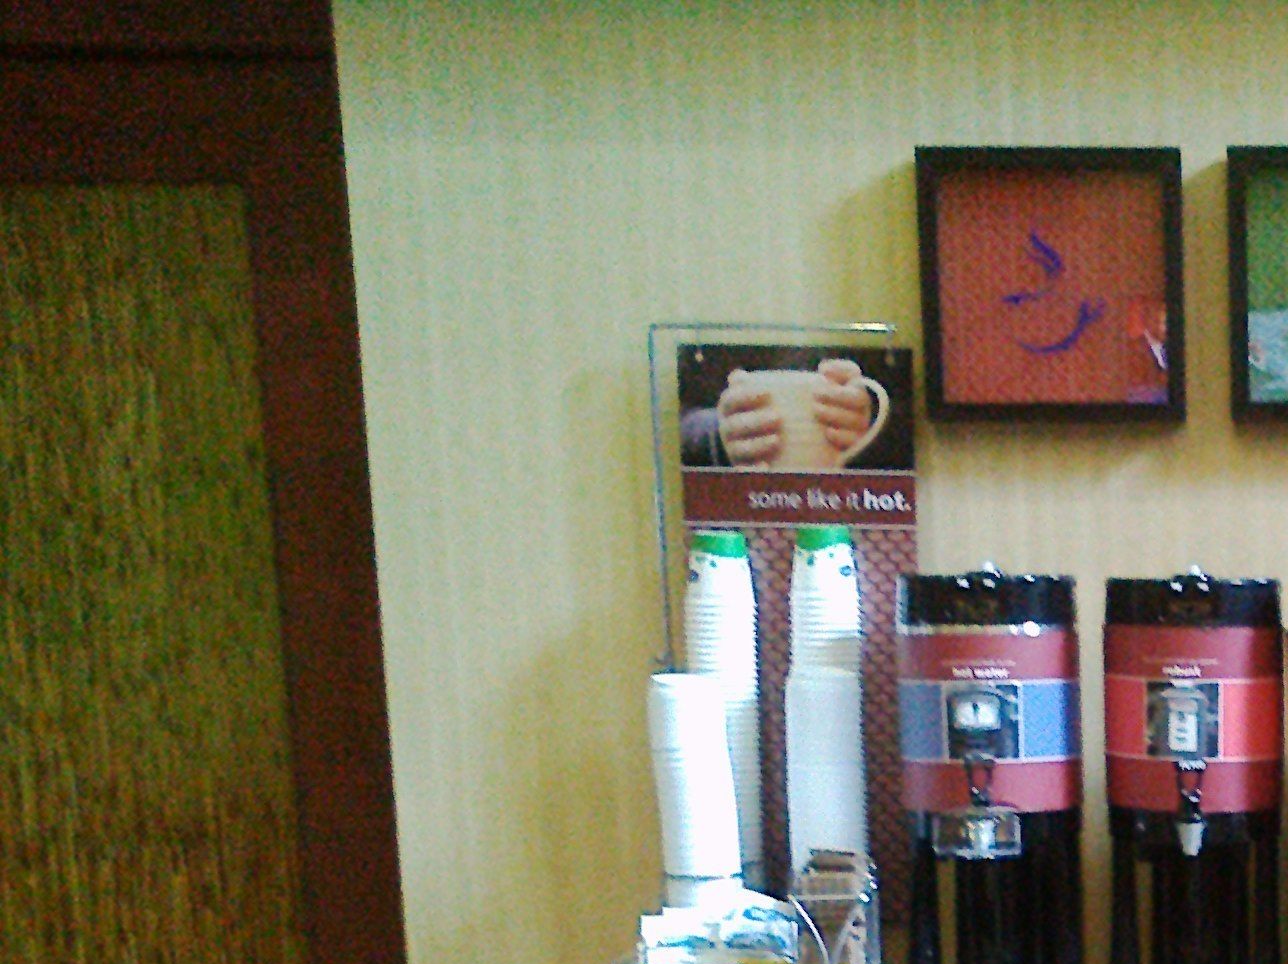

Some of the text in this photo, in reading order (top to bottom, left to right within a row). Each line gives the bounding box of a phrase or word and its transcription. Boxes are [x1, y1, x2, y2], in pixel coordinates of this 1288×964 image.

[748, 487, 911, 511] some like it hot.
